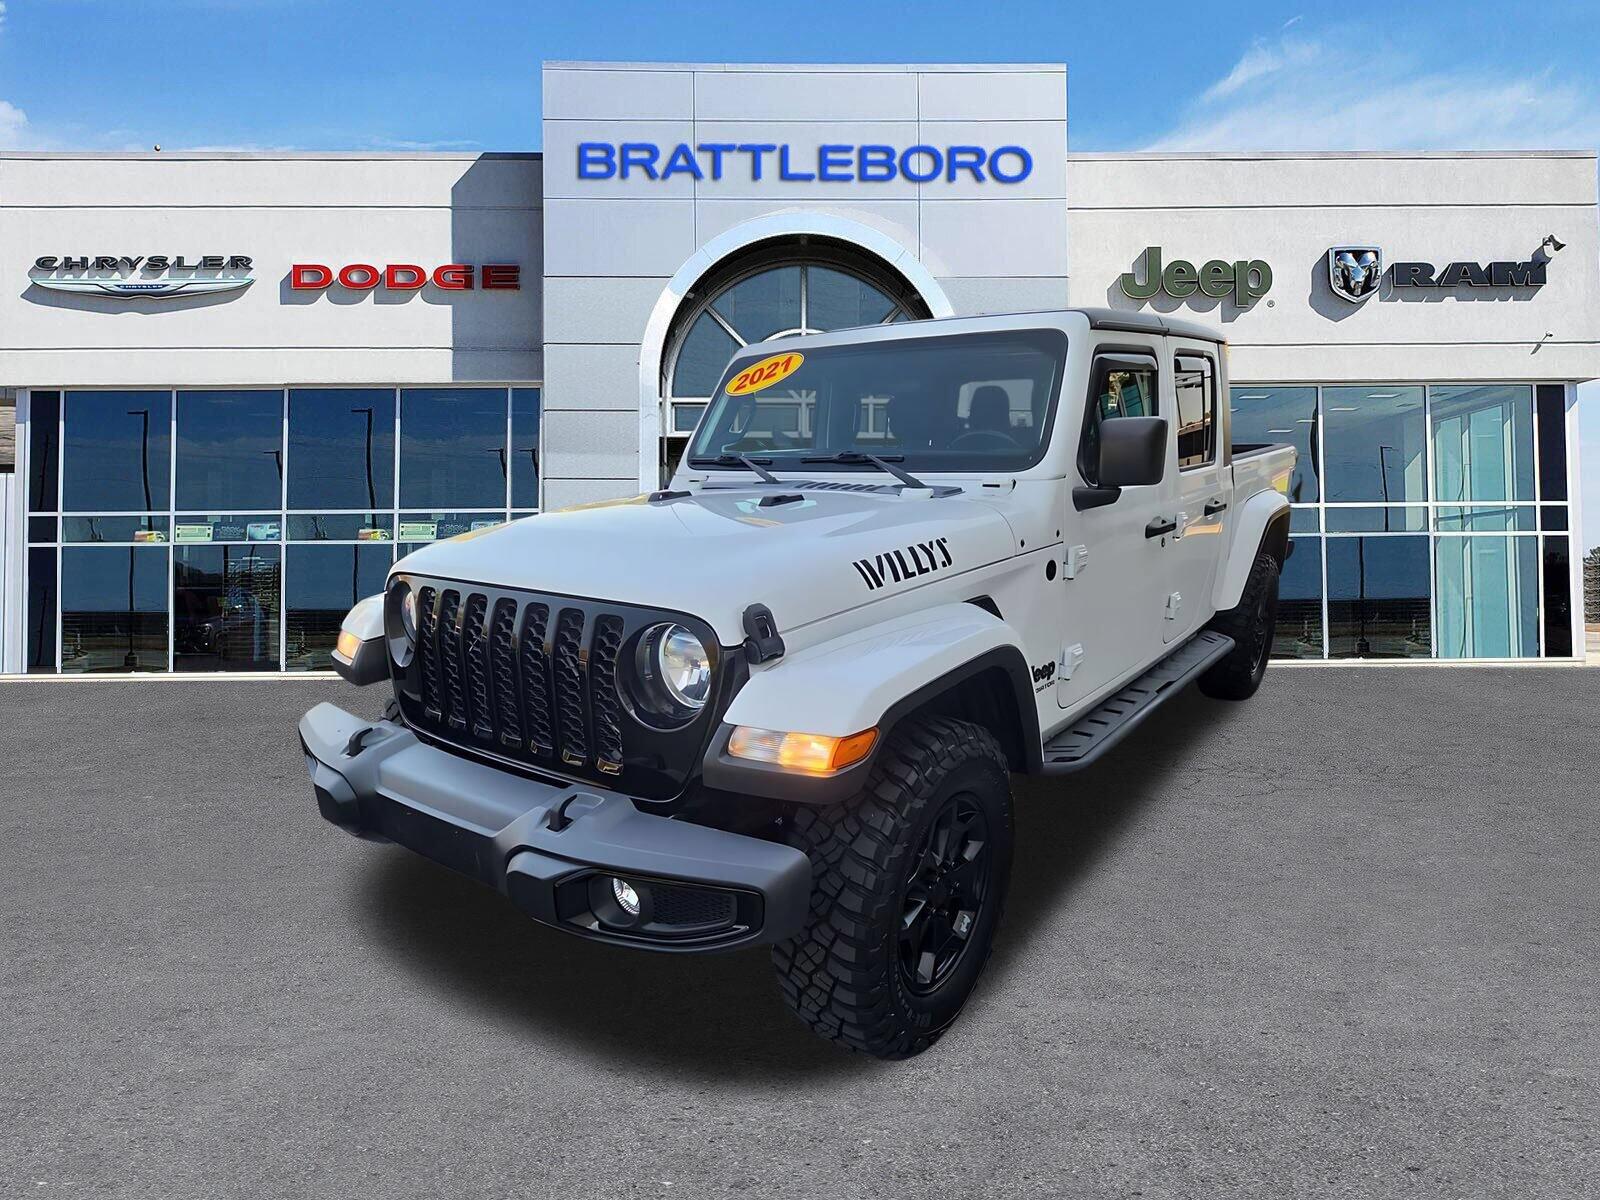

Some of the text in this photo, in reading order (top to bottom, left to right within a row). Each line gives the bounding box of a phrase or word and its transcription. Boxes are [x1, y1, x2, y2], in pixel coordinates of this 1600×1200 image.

[577, 143, 1033, 183] BRATTLEBORO
[35, 255, 254, 271] CHRYSLER
[292, 264, 521, 290] DODGE
[1121, 246, 1273, 306] Jeep
[1392, 261, 1546, 286] RAM
[733, 356, 794, 392] 2021
[852, 537, 952, 590] WILLYS
